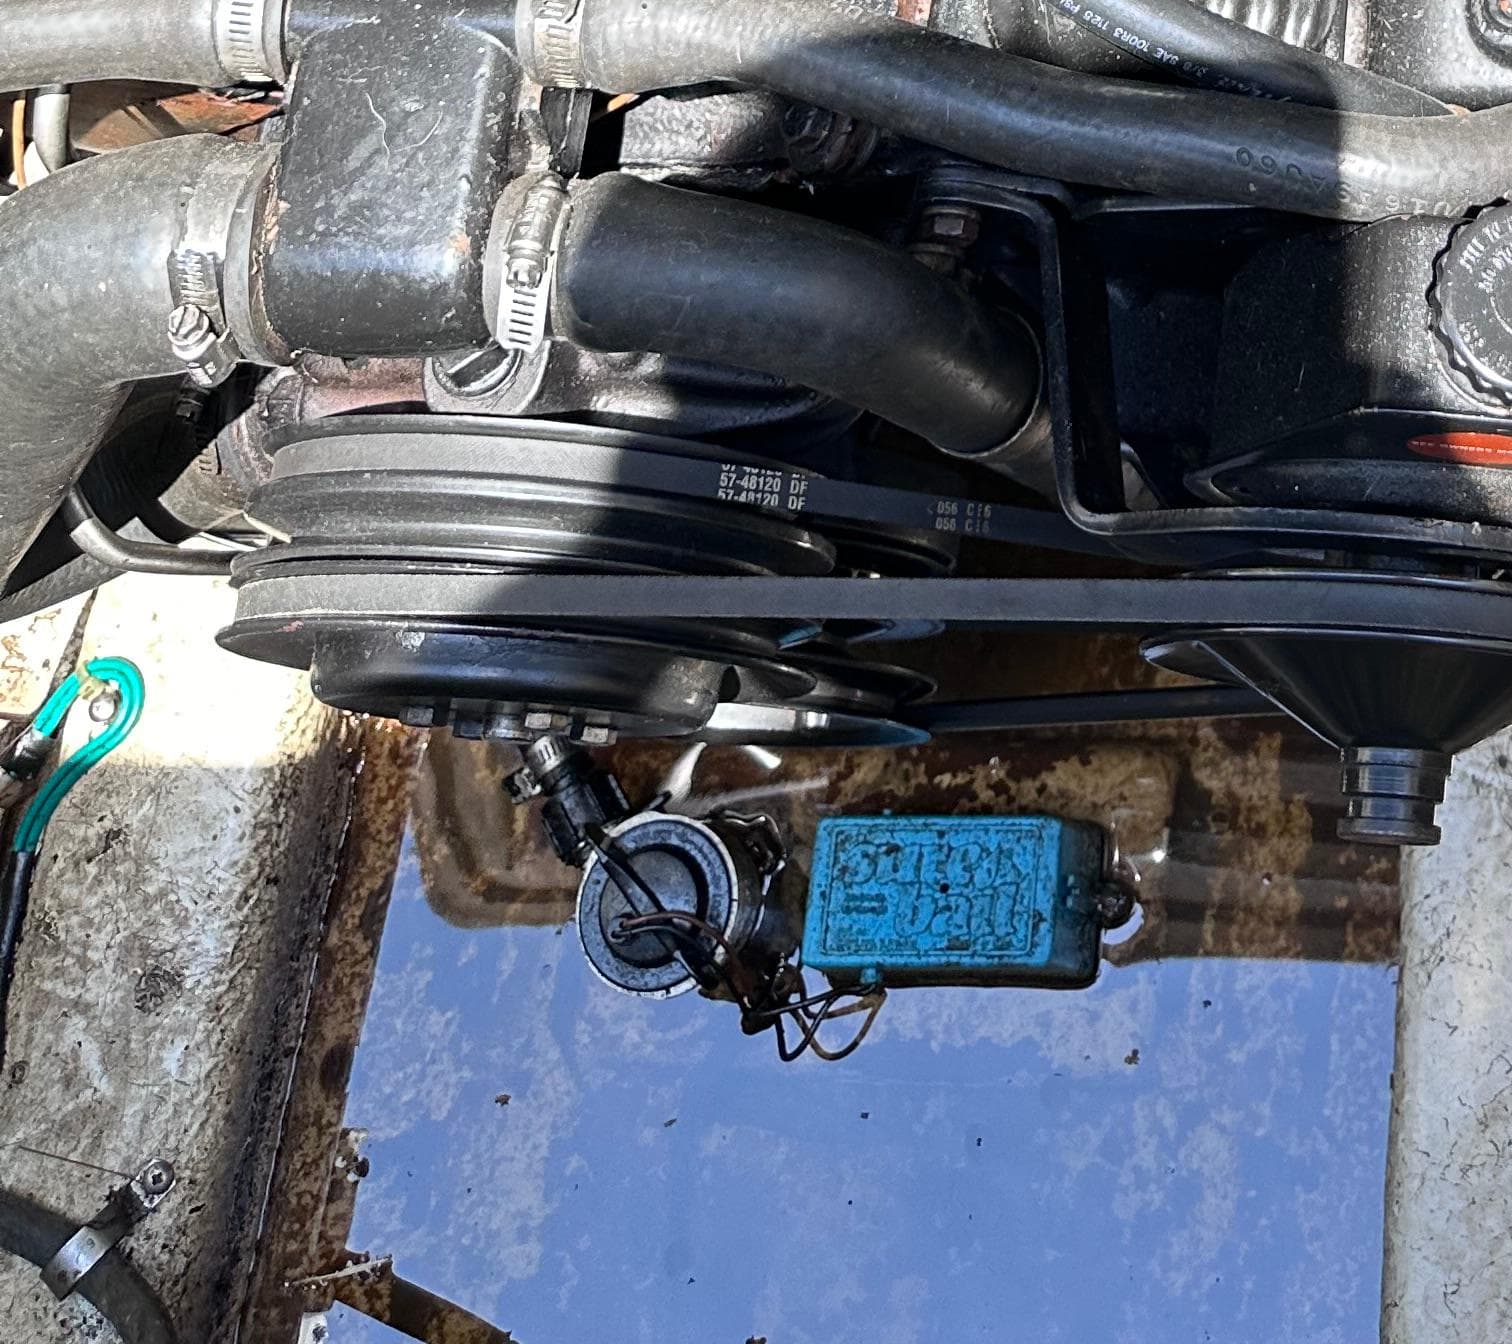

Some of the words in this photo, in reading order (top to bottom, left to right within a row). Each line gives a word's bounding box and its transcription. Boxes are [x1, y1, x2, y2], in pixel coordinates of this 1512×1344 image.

[1153, 47, 1179, 66] SAE
[719, 473, 782, 493] 57-48120
[789, 480, 809, 496] DF
